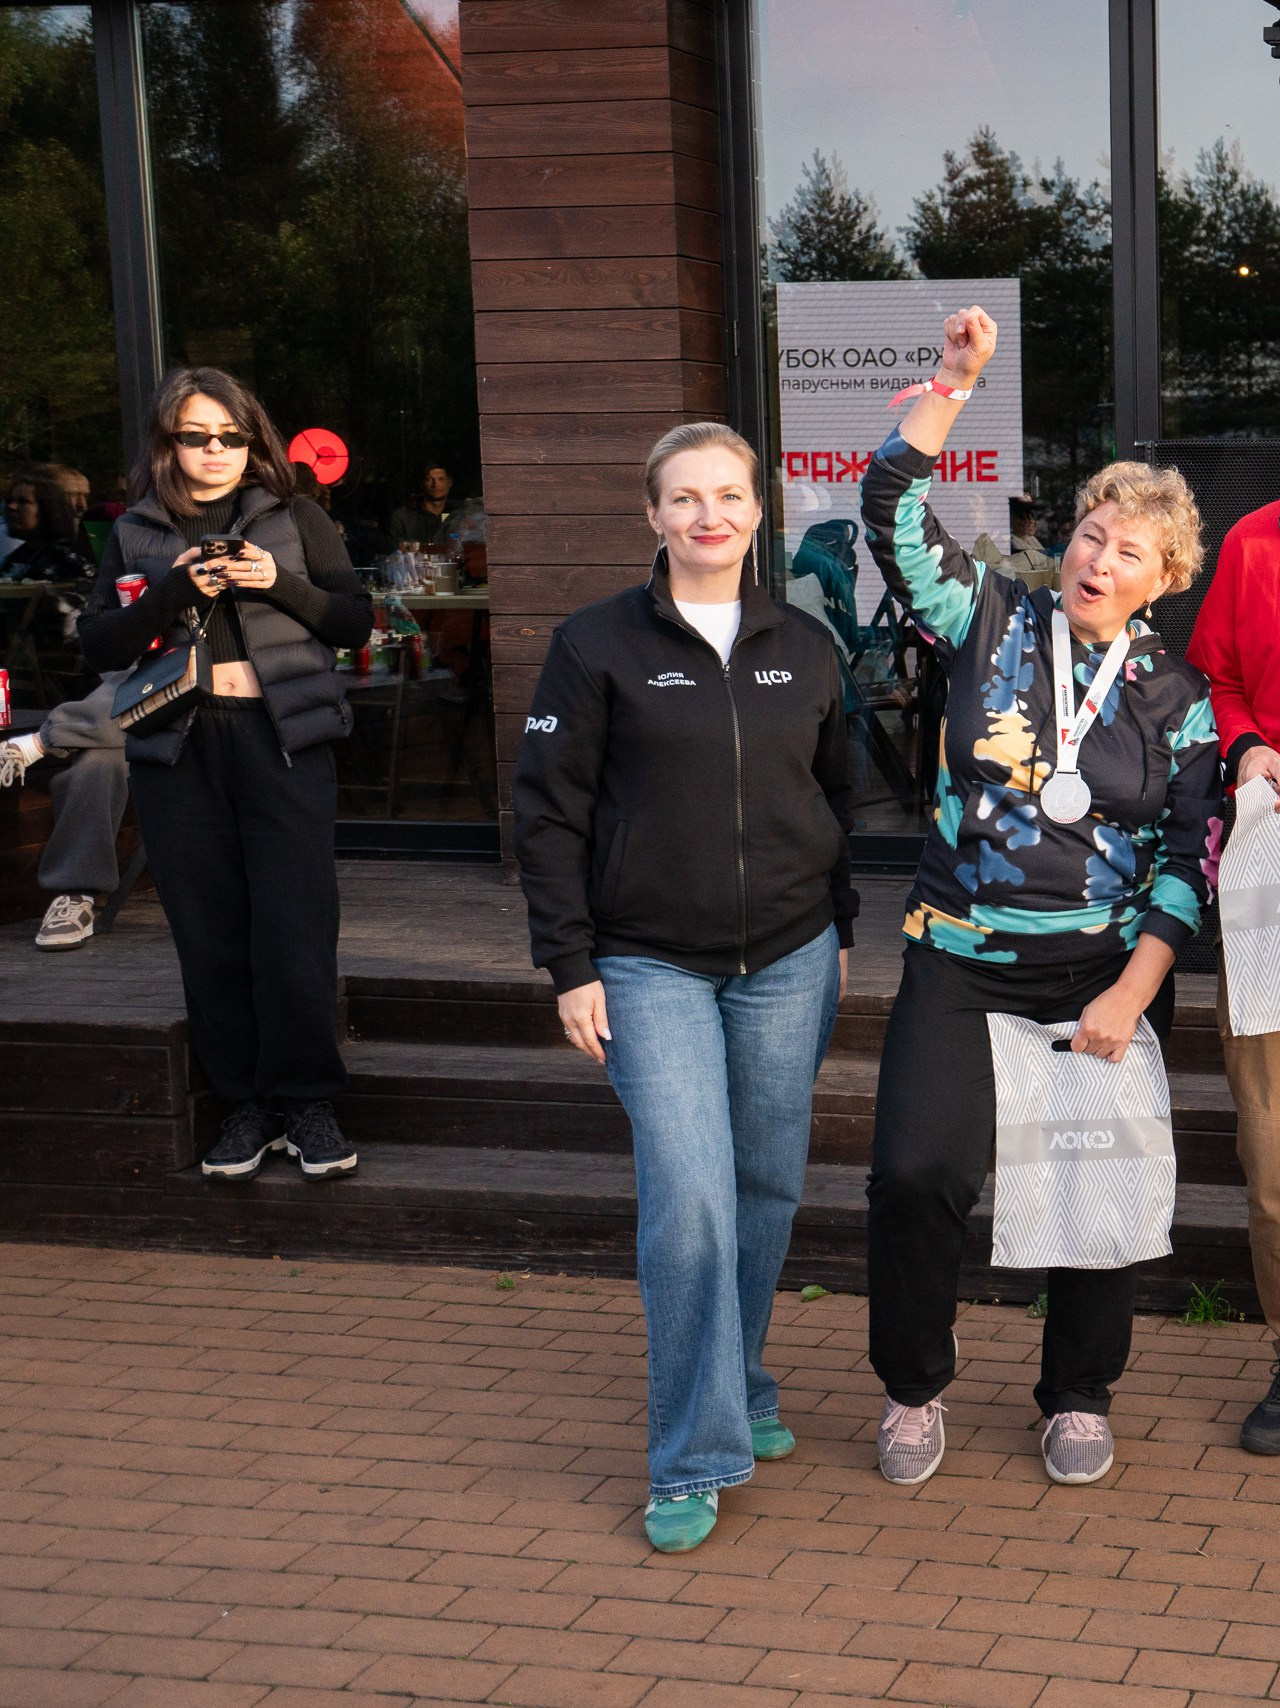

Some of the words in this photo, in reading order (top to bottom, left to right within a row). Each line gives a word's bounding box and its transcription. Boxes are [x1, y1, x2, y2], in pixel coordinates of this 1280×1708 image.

[779, 348, 836, 368] УБОК
[843, 347, 897, 368] ОАО
[781, 378, 865, 393] парусным
[870, 377, 923, 391] видам
[647, 679, 697, 688] АЛЕКСЕЕВА
[657, 672, 685, 681] ЮЛИЯ
[754, 670, 793, 686] ЦСР
